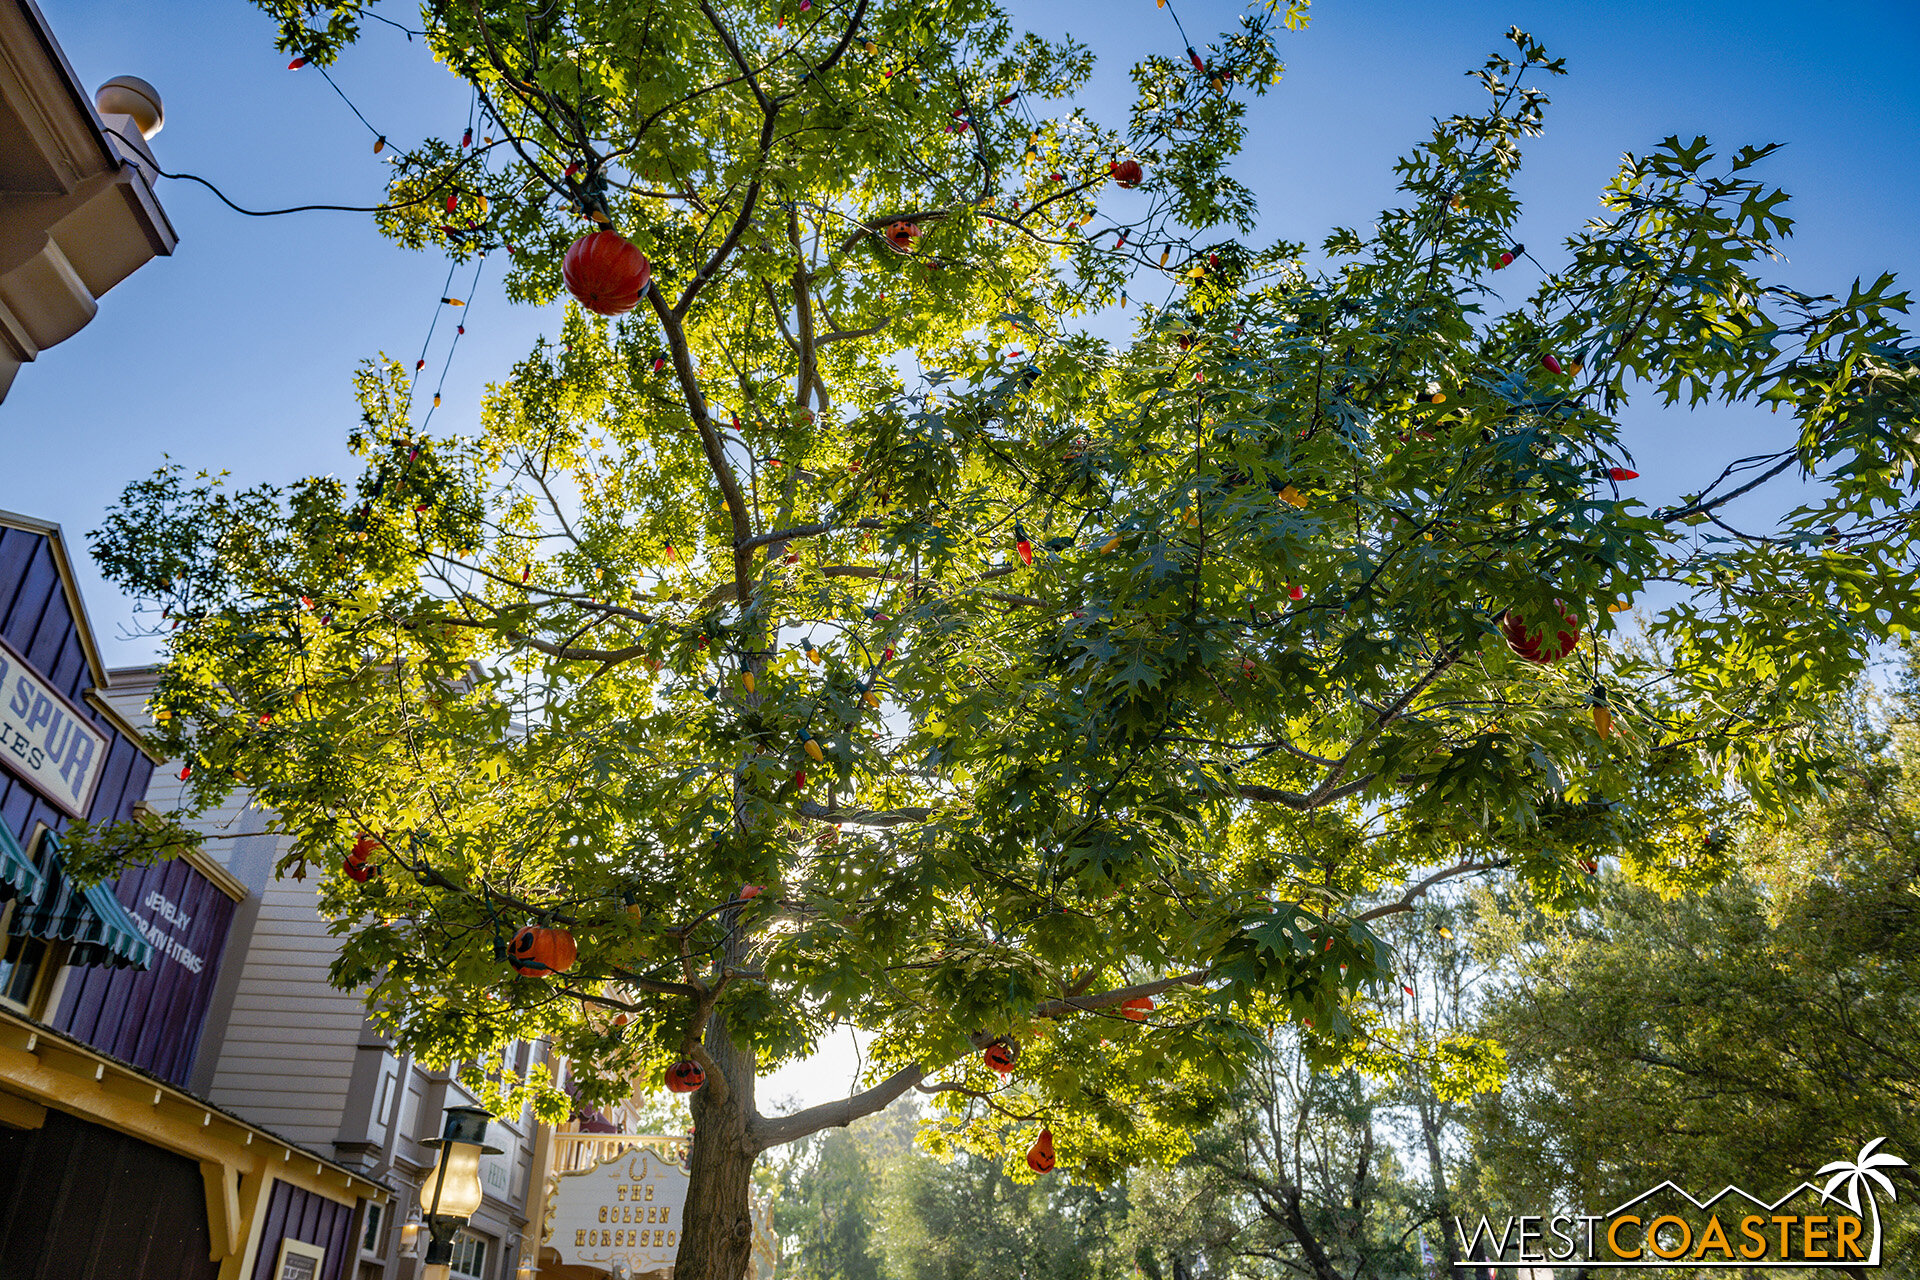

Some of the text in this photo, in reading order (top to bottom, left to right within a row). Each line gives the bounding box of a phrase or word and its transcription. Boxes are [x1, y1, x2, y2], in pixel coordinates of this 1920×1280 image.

[9, 675, 95, 801] SPUR
[617, 1184, 654, 1201] THE
[598, 1205, 670, 1223] GOLDEN
[574, 1229, 682, 1247] HORSESHO
